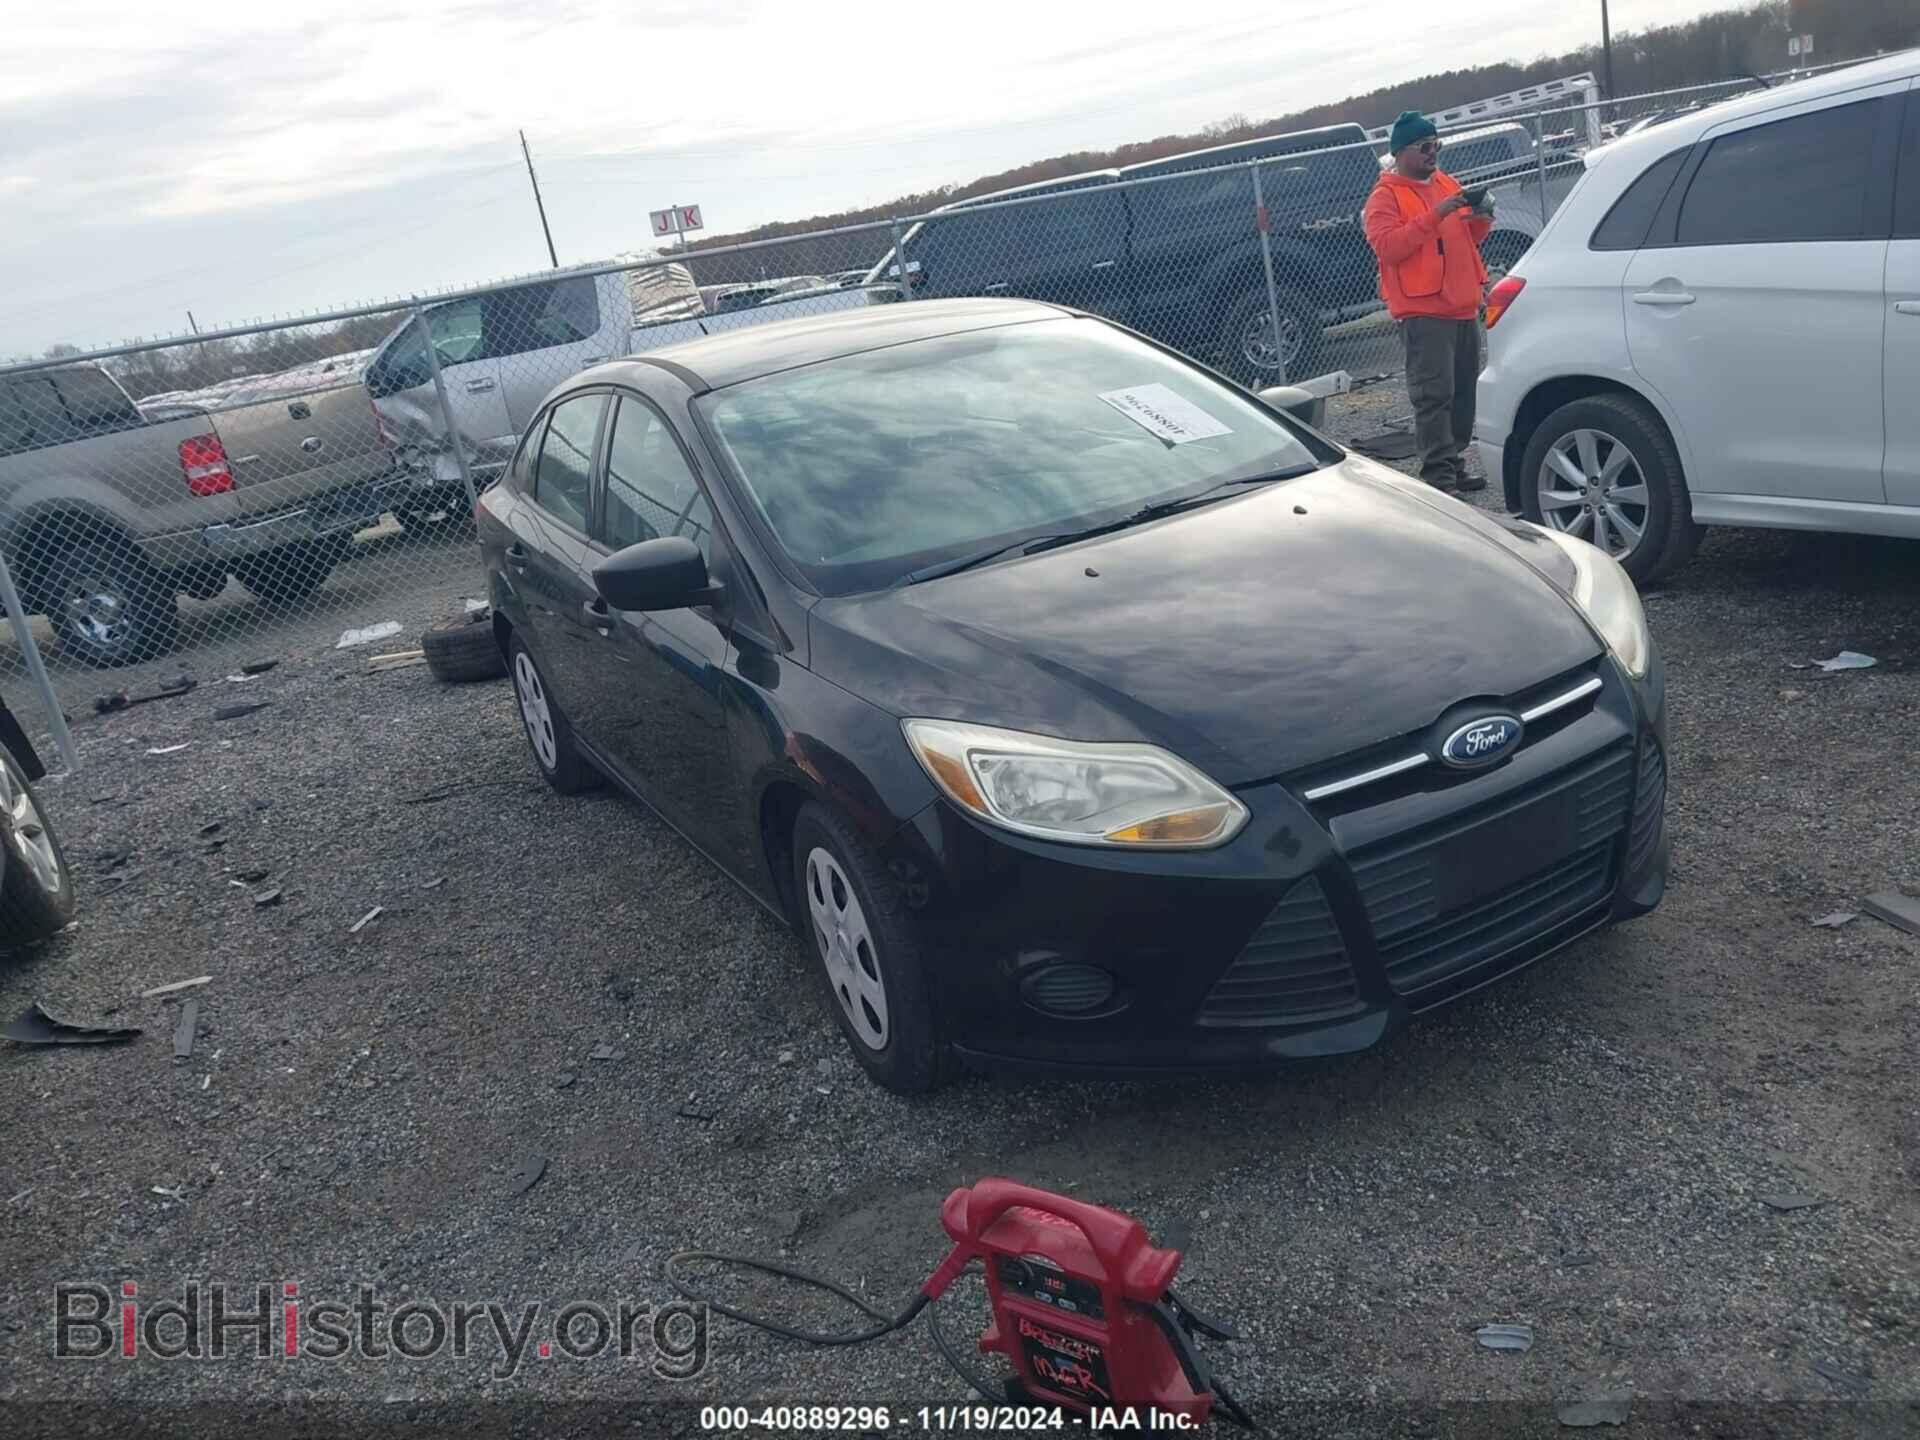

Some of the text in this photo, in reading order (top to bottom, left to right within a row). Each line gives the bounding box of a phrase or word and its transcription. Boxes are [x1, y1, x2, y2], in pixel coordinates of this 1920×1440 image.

[658, 209, 699, 231] J K
[1466, 724, 1505, 756] Ford
